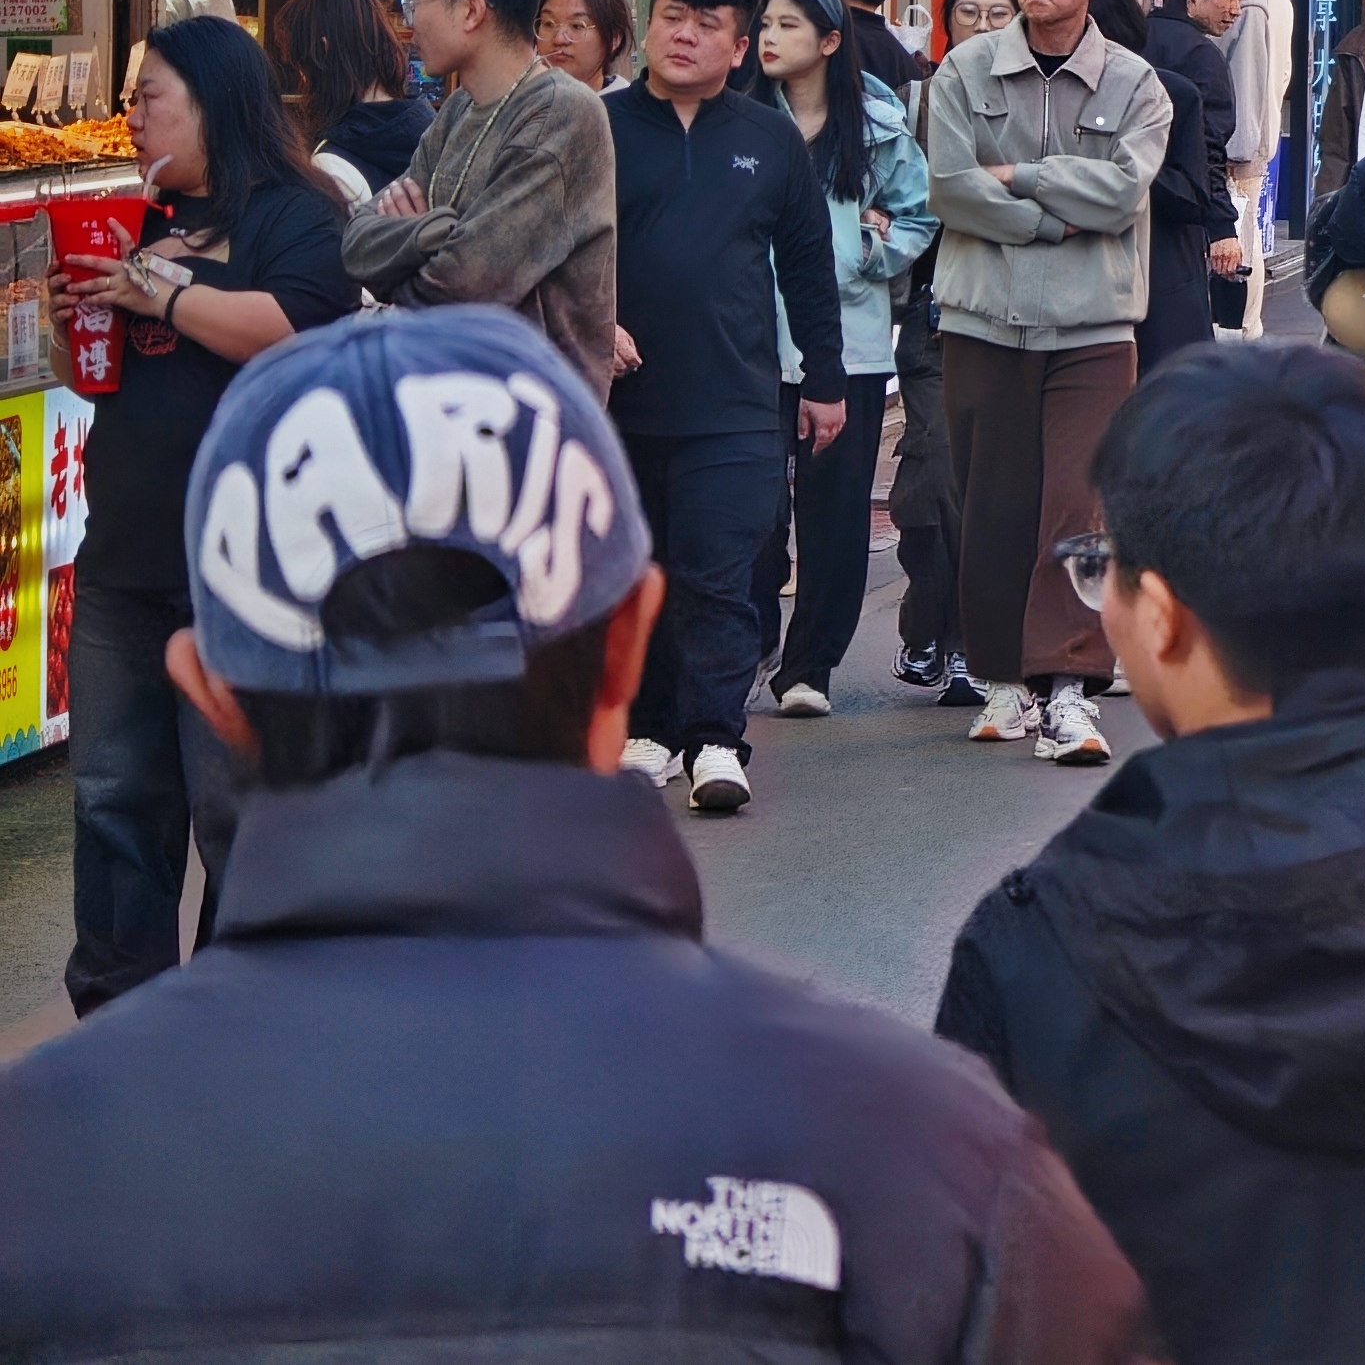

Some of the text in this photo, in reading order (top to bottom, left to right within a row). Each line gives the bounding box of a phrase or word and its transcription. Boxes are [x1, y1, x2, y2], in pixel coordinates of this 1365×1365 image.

[200, 370, 612, 652] PARIS
[707, 1176, 786, 1208] THE
[651, 1197, 786, 1245] NORTH
[684, 1237, 786, 1275] FACE
